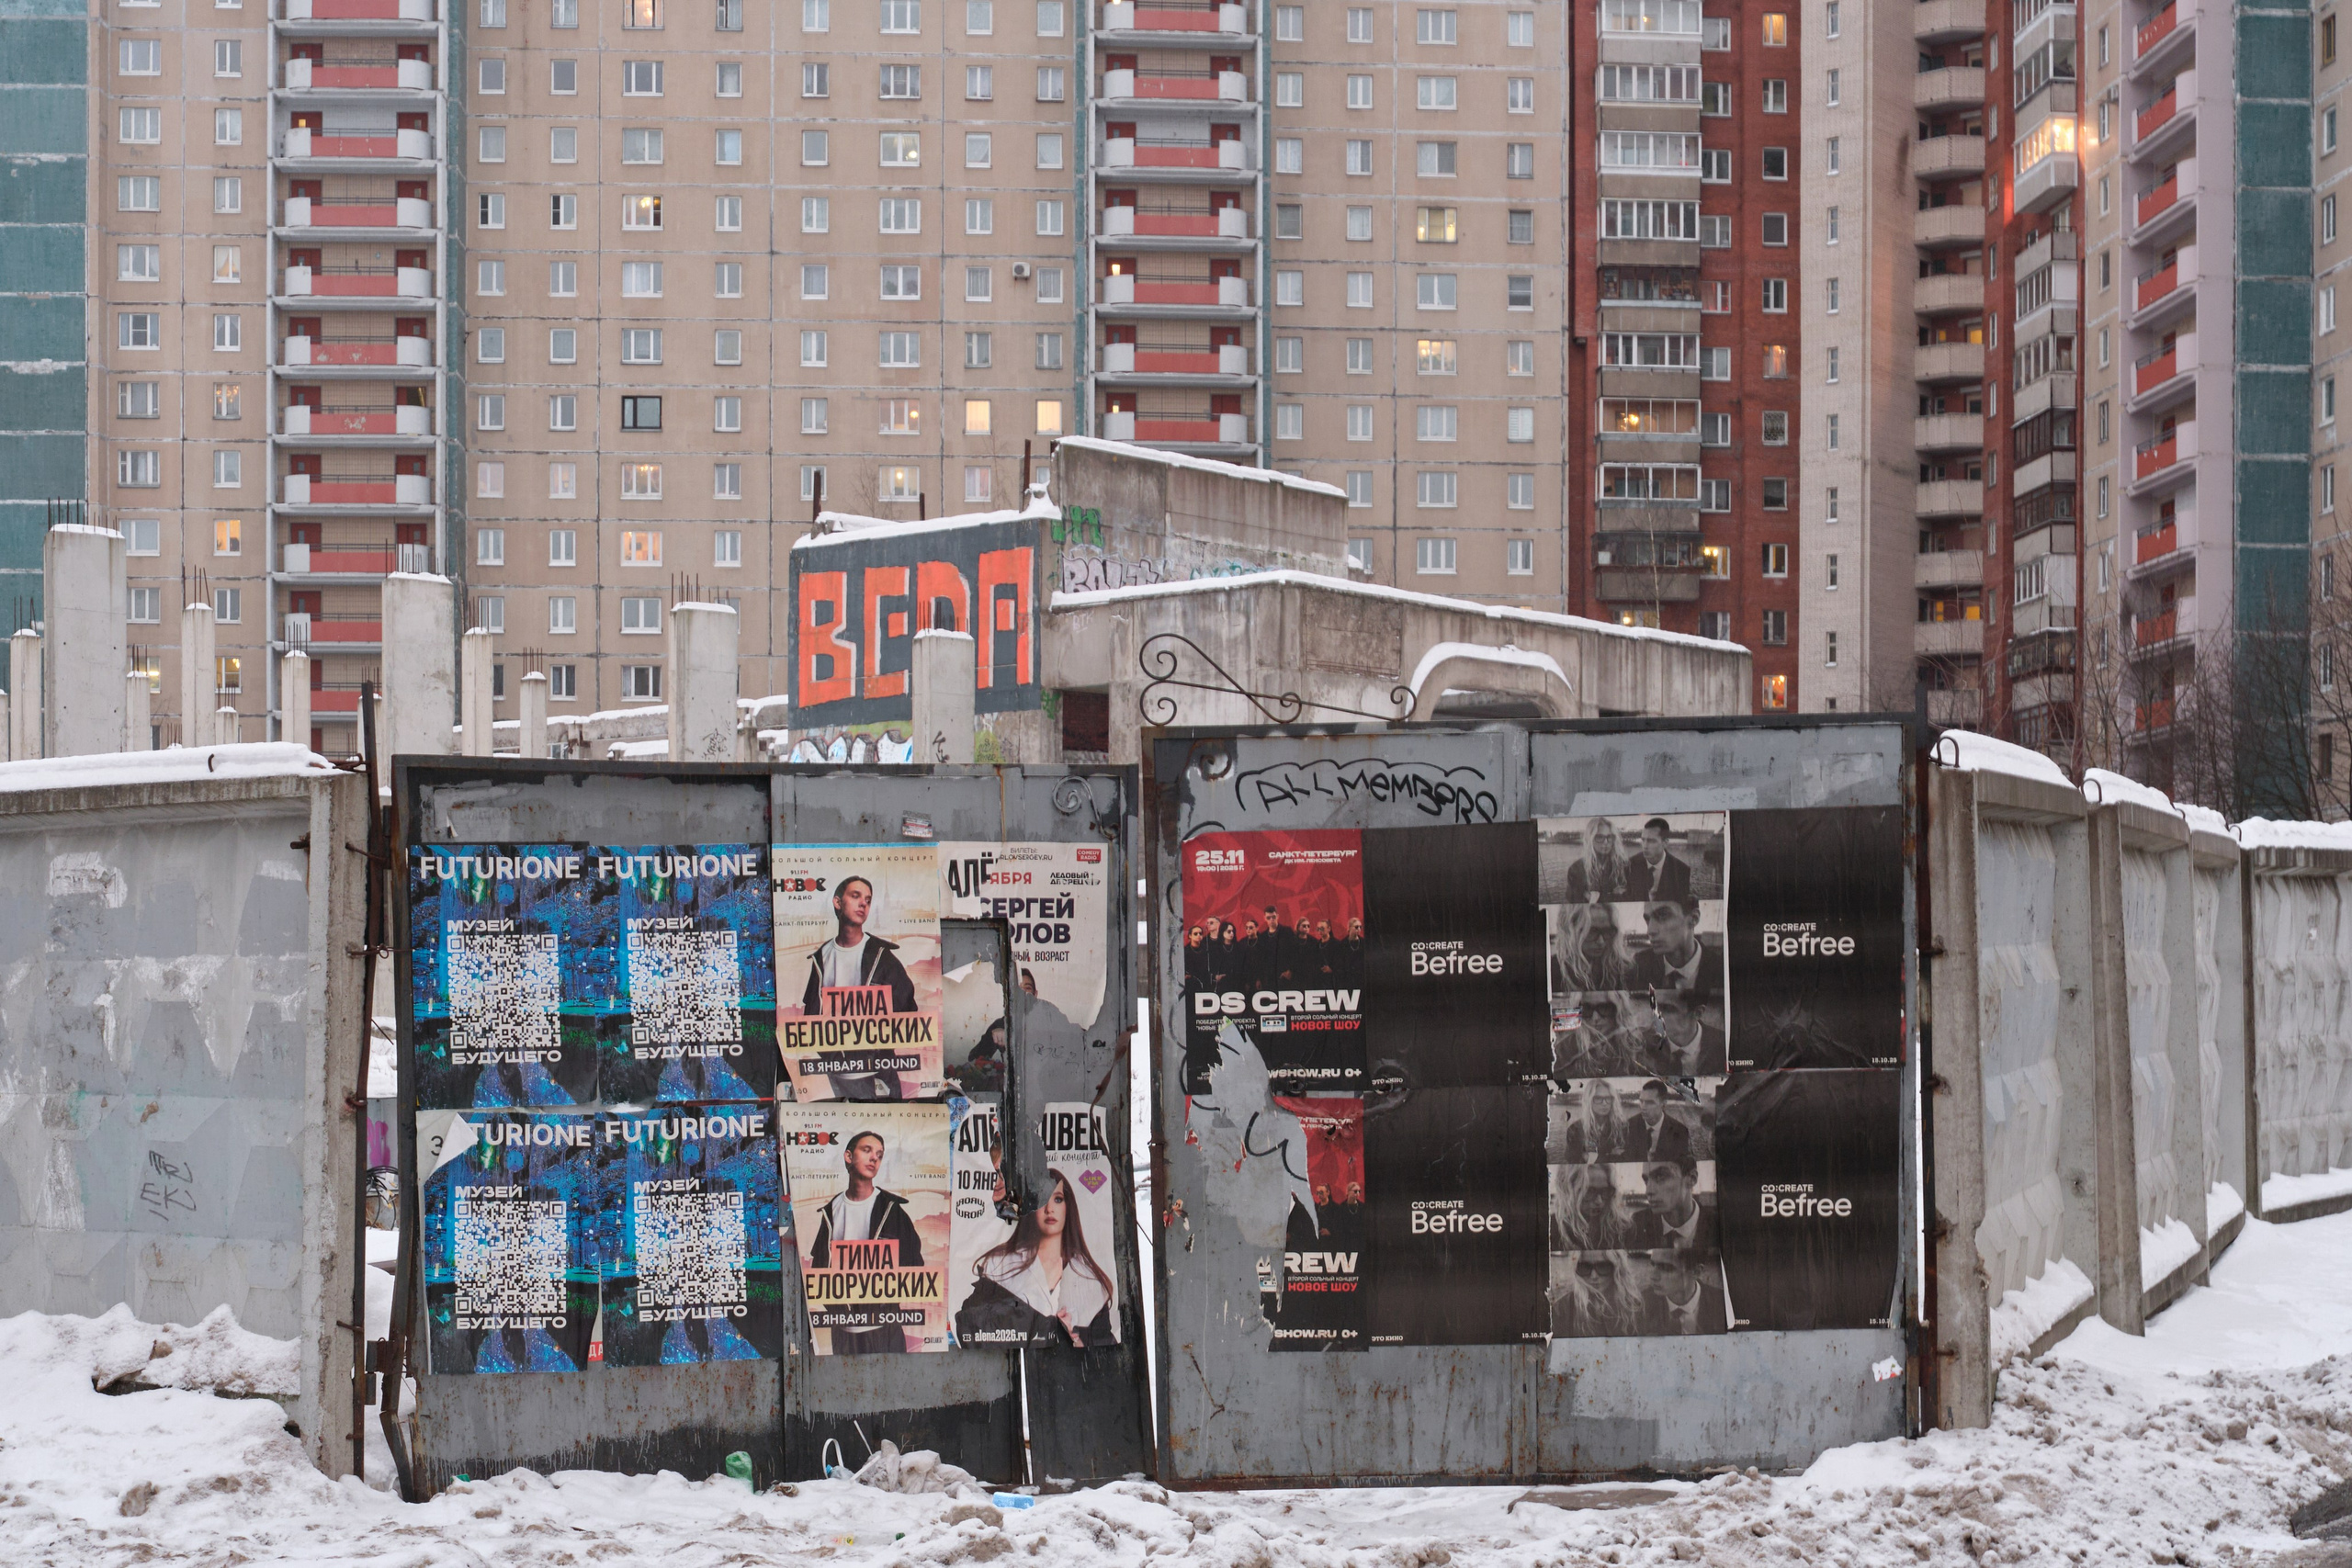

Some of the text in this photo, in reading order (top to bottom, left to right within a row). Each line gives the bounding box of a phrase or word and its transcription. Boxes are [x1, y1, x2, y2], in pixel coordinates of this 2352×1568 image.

[1195, 849, 1245, 865] 25.11
[1268, 850, 1358, 859] САНКТ-ПЕТЕРБУРГ
[420, 856, 580, 880] FUTURIONE
[599, 854, 757, 876] FUTURIONE
[980, 891, 1075, 919] СЕРГЕЙ
[447, 918, 514, 932] МУЗЕЙ
[627, 916, 693, 931] МУЗЕЙ
[1763, 922, 1816, 932] CO:CREATE
[1411, 941, 1464, 950] CO:CREATE
[1763, 932, 1856, 957] Befree
[1035, 951, 1069, 961] ВОЗРАСТ
[1411, 951, 1503, 976] Befree
[827, 989, 888, 1017] ТИМА
[1194, 988, 1361, 1015] DS CREW
[785, 1016, 933, 1049] БЕЛОРУССКИХ
[1291, 1020, 1361, 1032] НОВОЕ ШОУ
[451, 1049, 561, 1066] БУДУЩЕГО
[634, 1043, 743, 1060] БУДУЩЕГО
[801, 1059, 864, 1073] 18 ЯНВАРЯ
[875, 1057, 918, 1070] SOUND
[1345, 1068, 1363, 1077] 0+
[605, 1115, 764, 1144] FUTURIONE
[634, 1178, 699, 1194] МУЗЕЙ
[957, 1170, 969, 1190] 10
[455, 1183, 523, 1198] МУЗЕЙ
[1761, 1184, 1814, 1192] CO:CREATE
[1411, 1200, 1464, 1209] CO:CREATE
[1760, 1192, 1852, 1218] Befree
[1411, 1209, 1503, 1235] Befree
[836, 1244, 894, 1270] ТИМА
[805, 1271, 939, 1300] ЕЛОРУССКИХ
[1288, 1282, 1358, 1292] НОВОЕ ШОУ
[639, 1305, 748, 1322] БУДУЩЕГО
[822, 1313, 868, 1325] ЯНВАРЯ
[878, 1312, 922, 1324] SOUND
[457, 1315, 567, 1330] БУДУЩЕГО
[975, 1329, 1028, 1342] alena2026.ru
[1274, 1328, 1337, 1338] SHOW.RU
[1341, 1328, 1358, 1338] 0+
